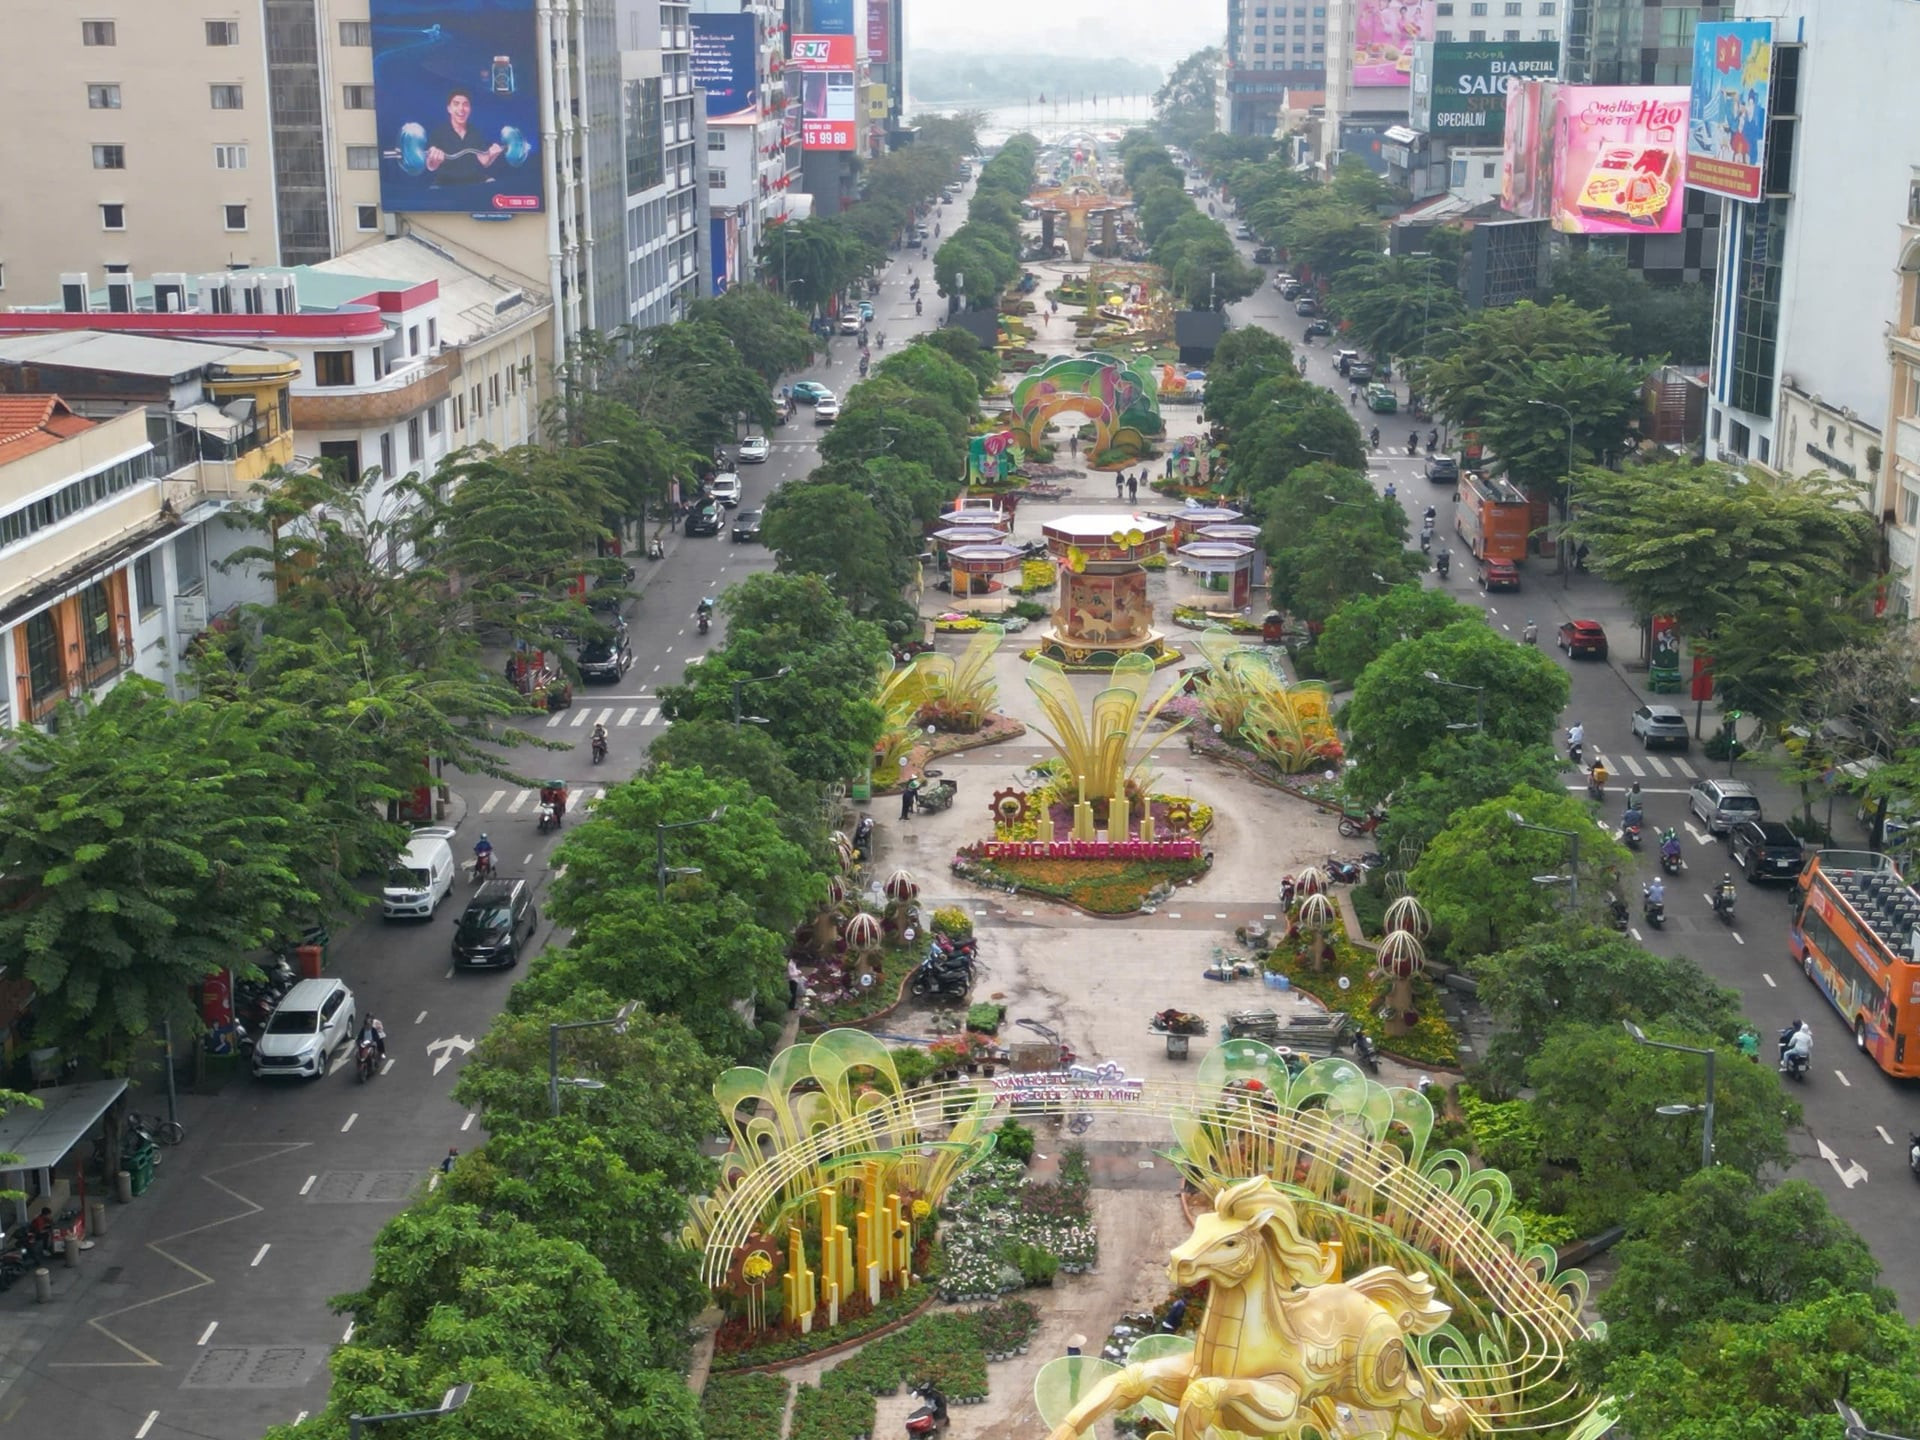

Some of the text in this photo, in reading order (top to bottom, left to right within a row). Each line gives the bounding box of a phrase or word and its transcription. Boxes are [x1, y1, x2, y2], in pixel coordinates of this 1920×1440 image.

[795, 43, 828, 57] SJK
[1491, 61, 1518, 73] BIA
[1518, 61, 1554, 71] SPEZIAL
